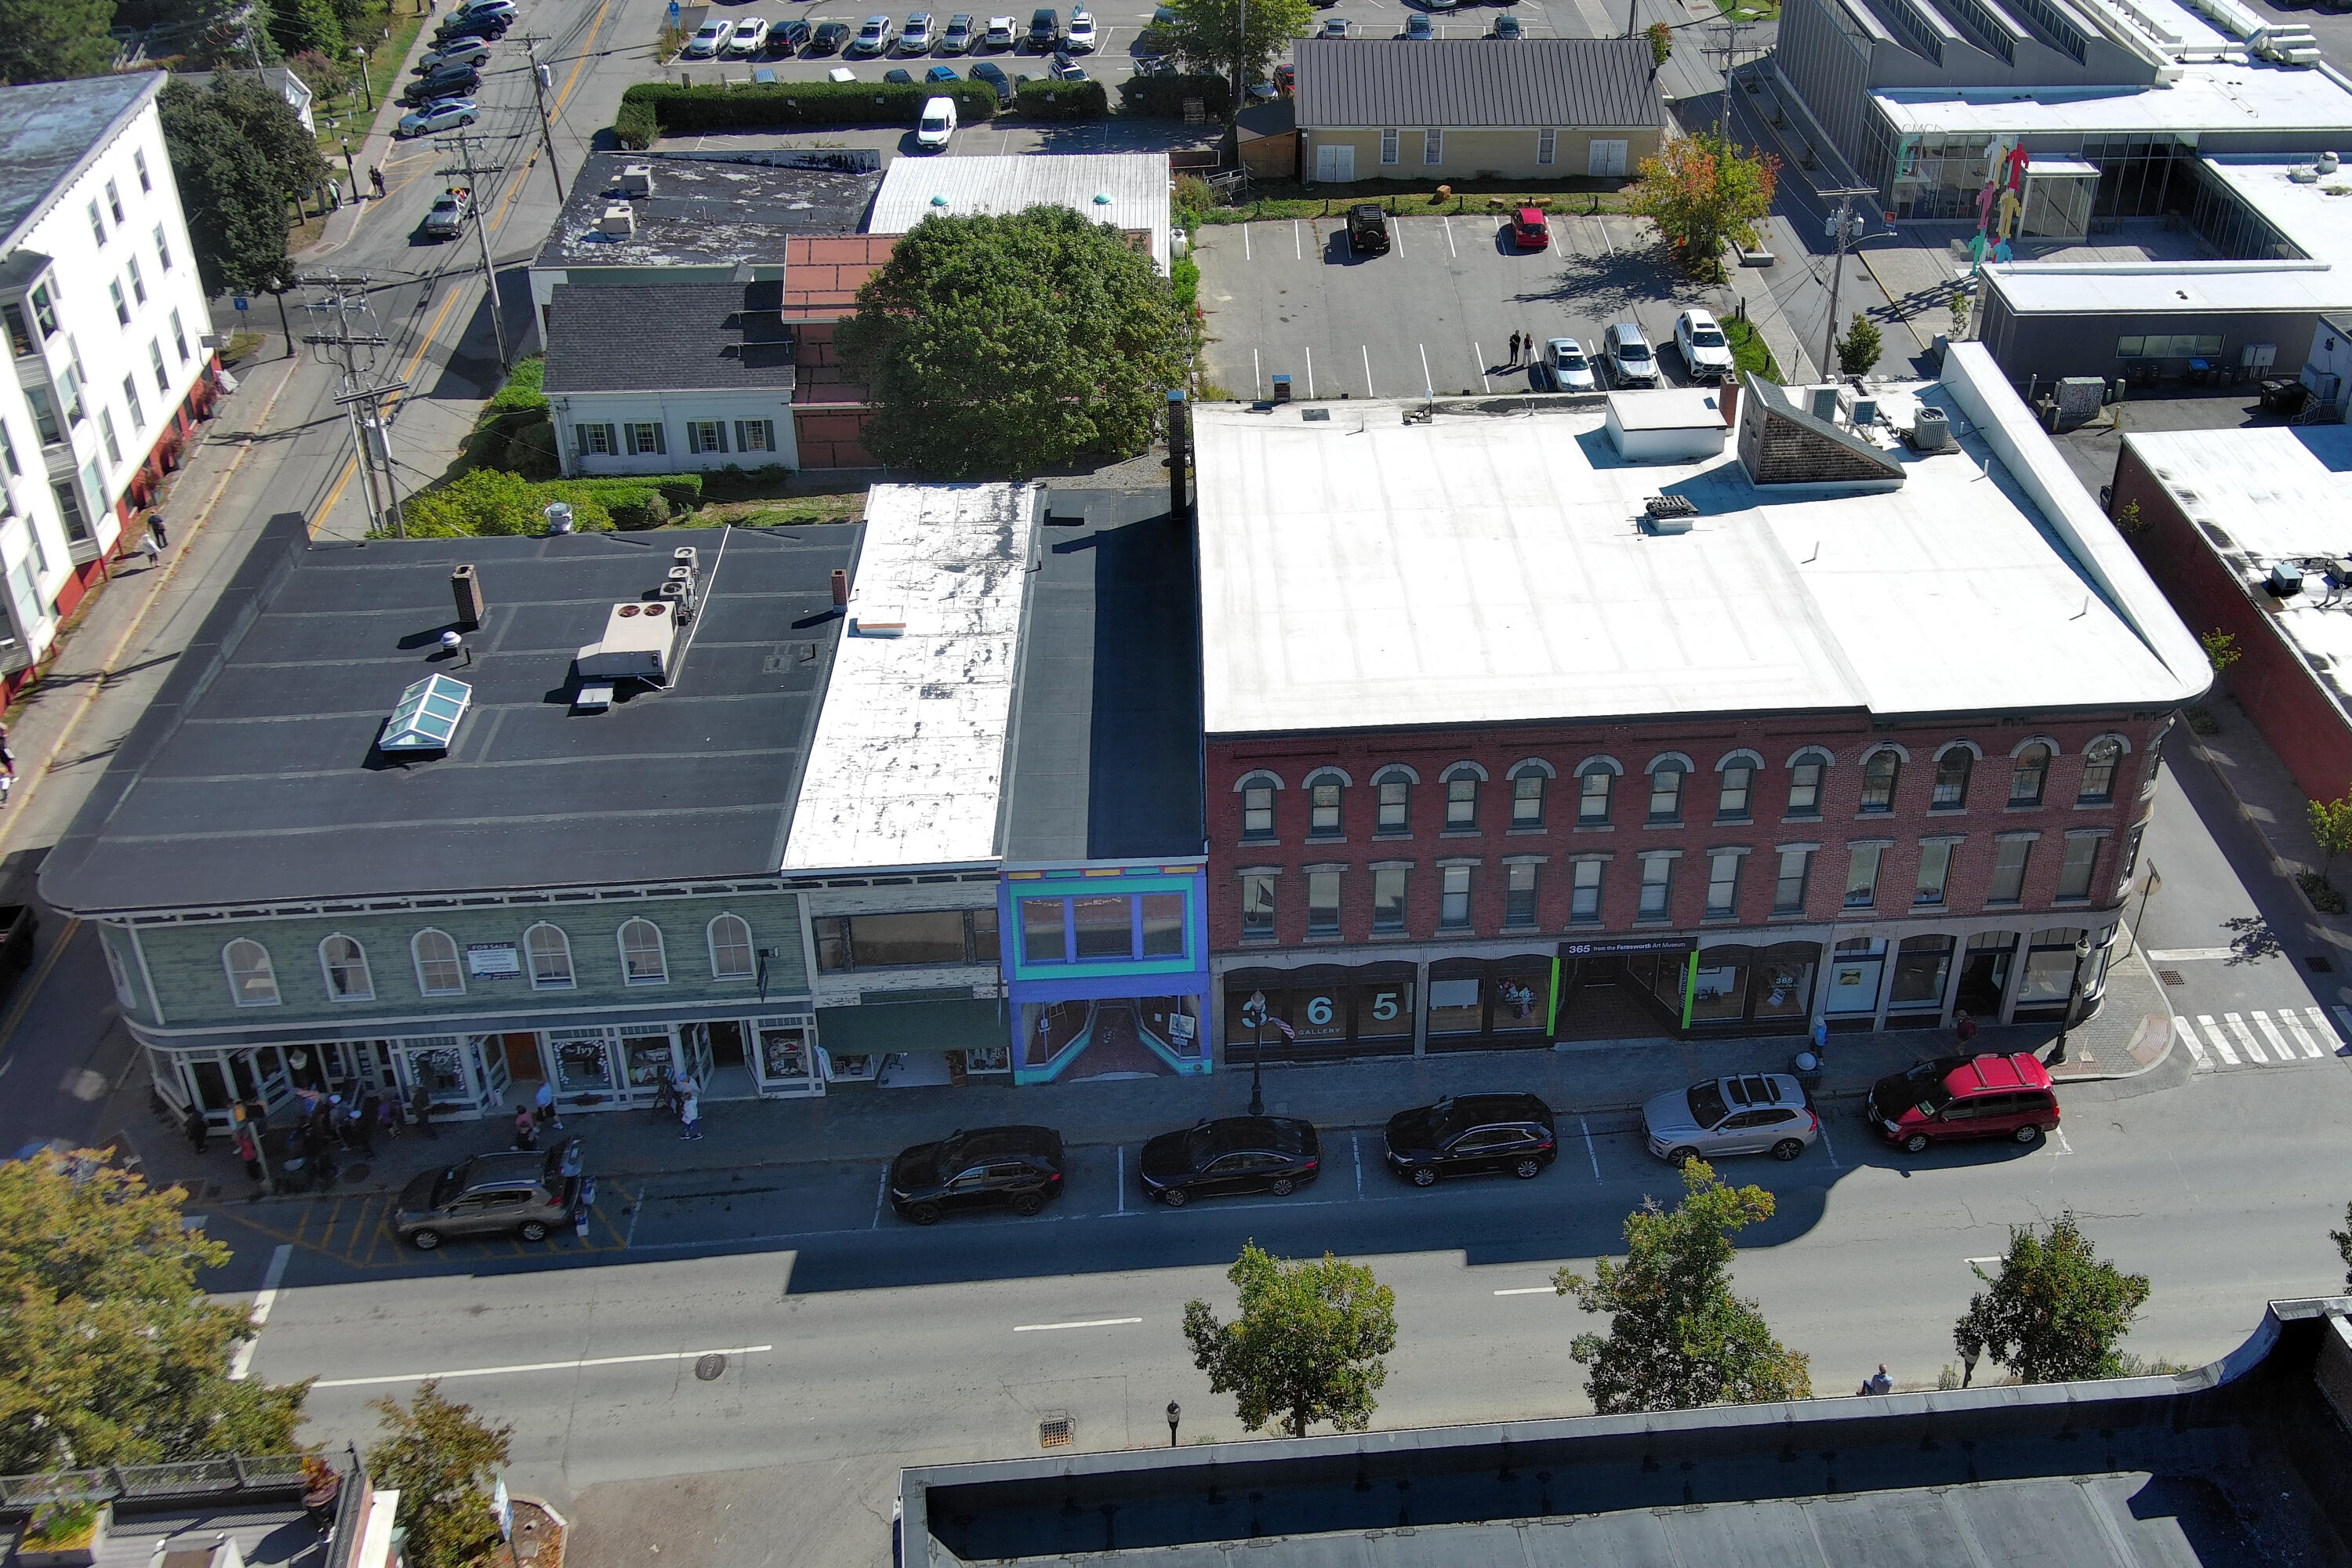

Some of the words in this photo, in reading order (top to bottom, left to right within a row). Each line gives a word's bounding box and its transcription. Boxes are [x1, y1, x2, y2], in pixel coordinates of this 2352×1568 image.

[1568, 945, 1591, 953] 365
[432, 1051, 451, 1065] Ivy
[576, 1045, 595, 1058] Ivy
